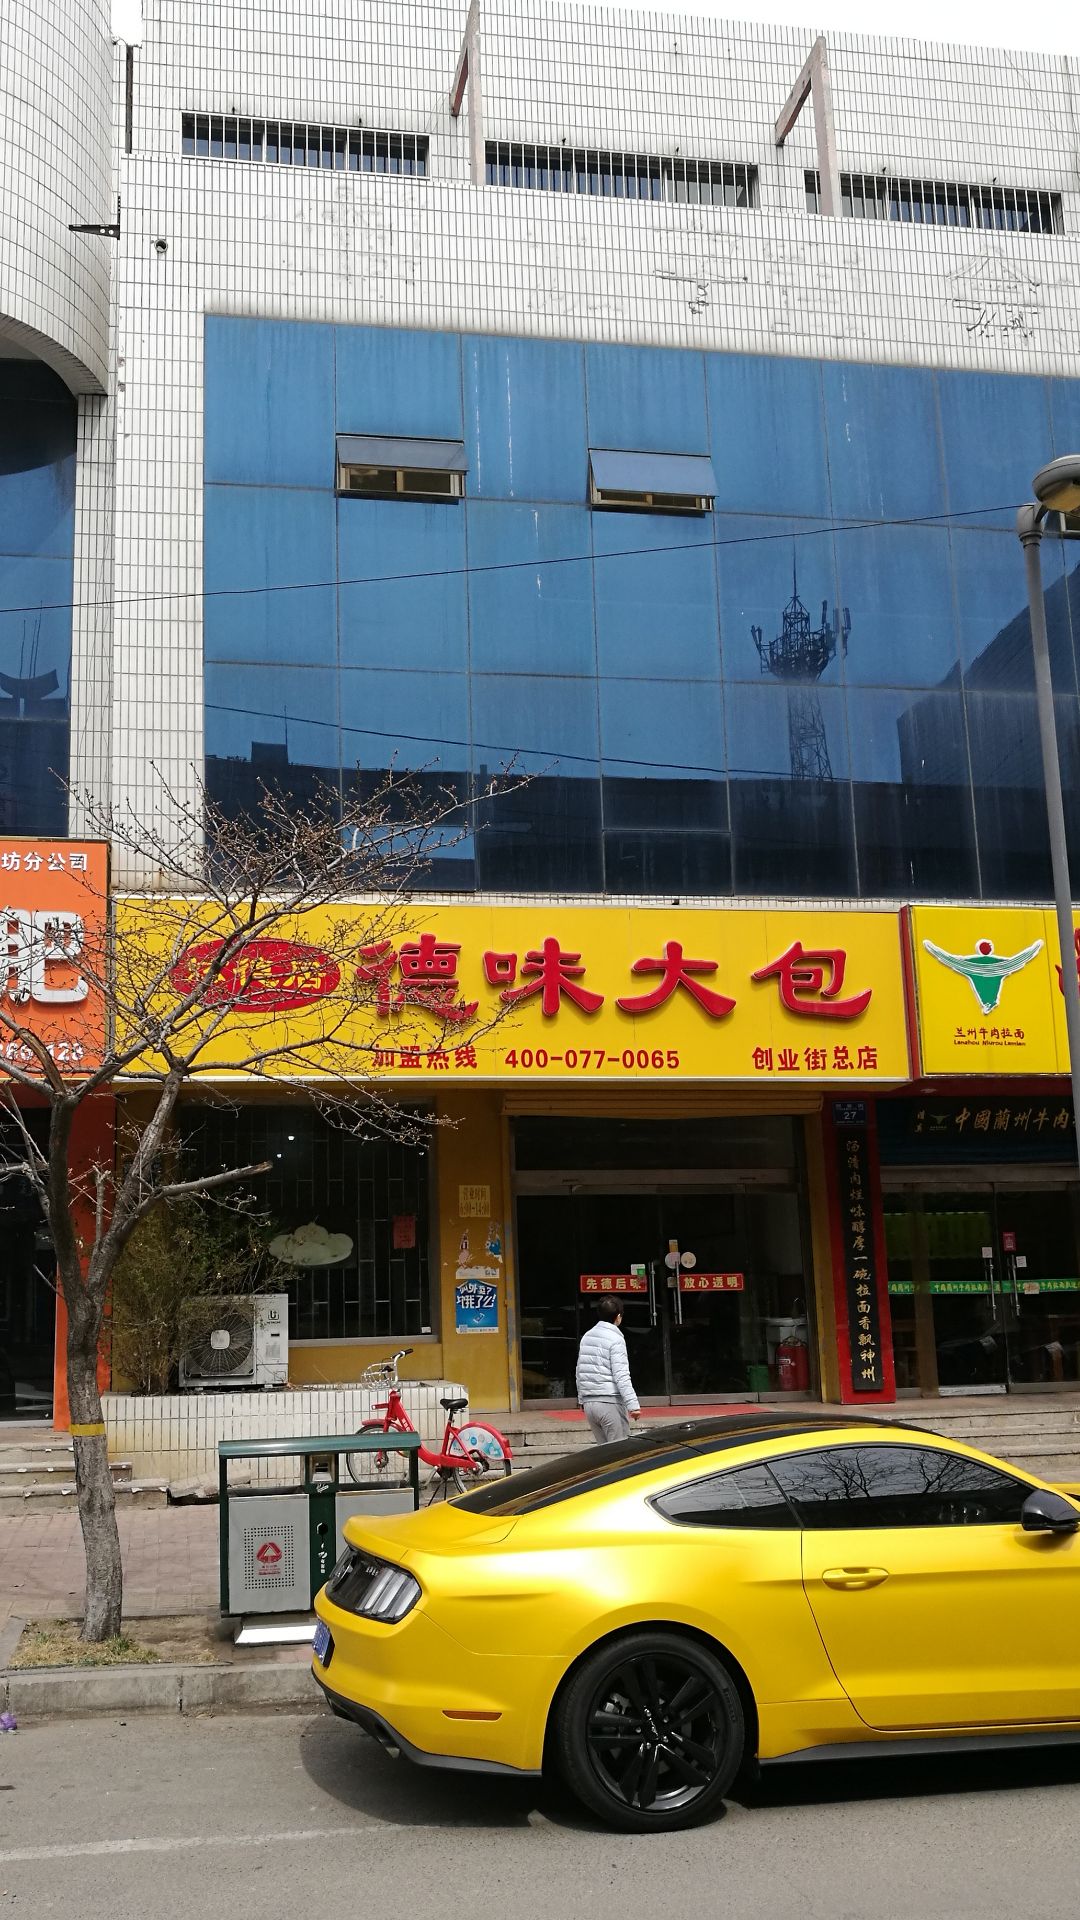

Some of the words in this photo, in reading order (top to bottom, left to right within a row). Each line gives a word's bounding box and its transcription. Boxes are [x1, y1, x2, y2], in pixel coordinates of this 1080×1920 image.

[1, 851, 88, 872] 坊分公司
[356, 932, 873, 1021] 德味大包
[954, 1027, 1025, 1040] 兰州牛肉拉面
[371, 1044, 479, 1070] 加盟热线
[505, 1048, 680, 1070] 400-077-0065
[752, 1046, 878, 1071] 创业街总店
[843, 1111, 857, 1120] 27
[684, 1276, 738, 1289] 放心透明
